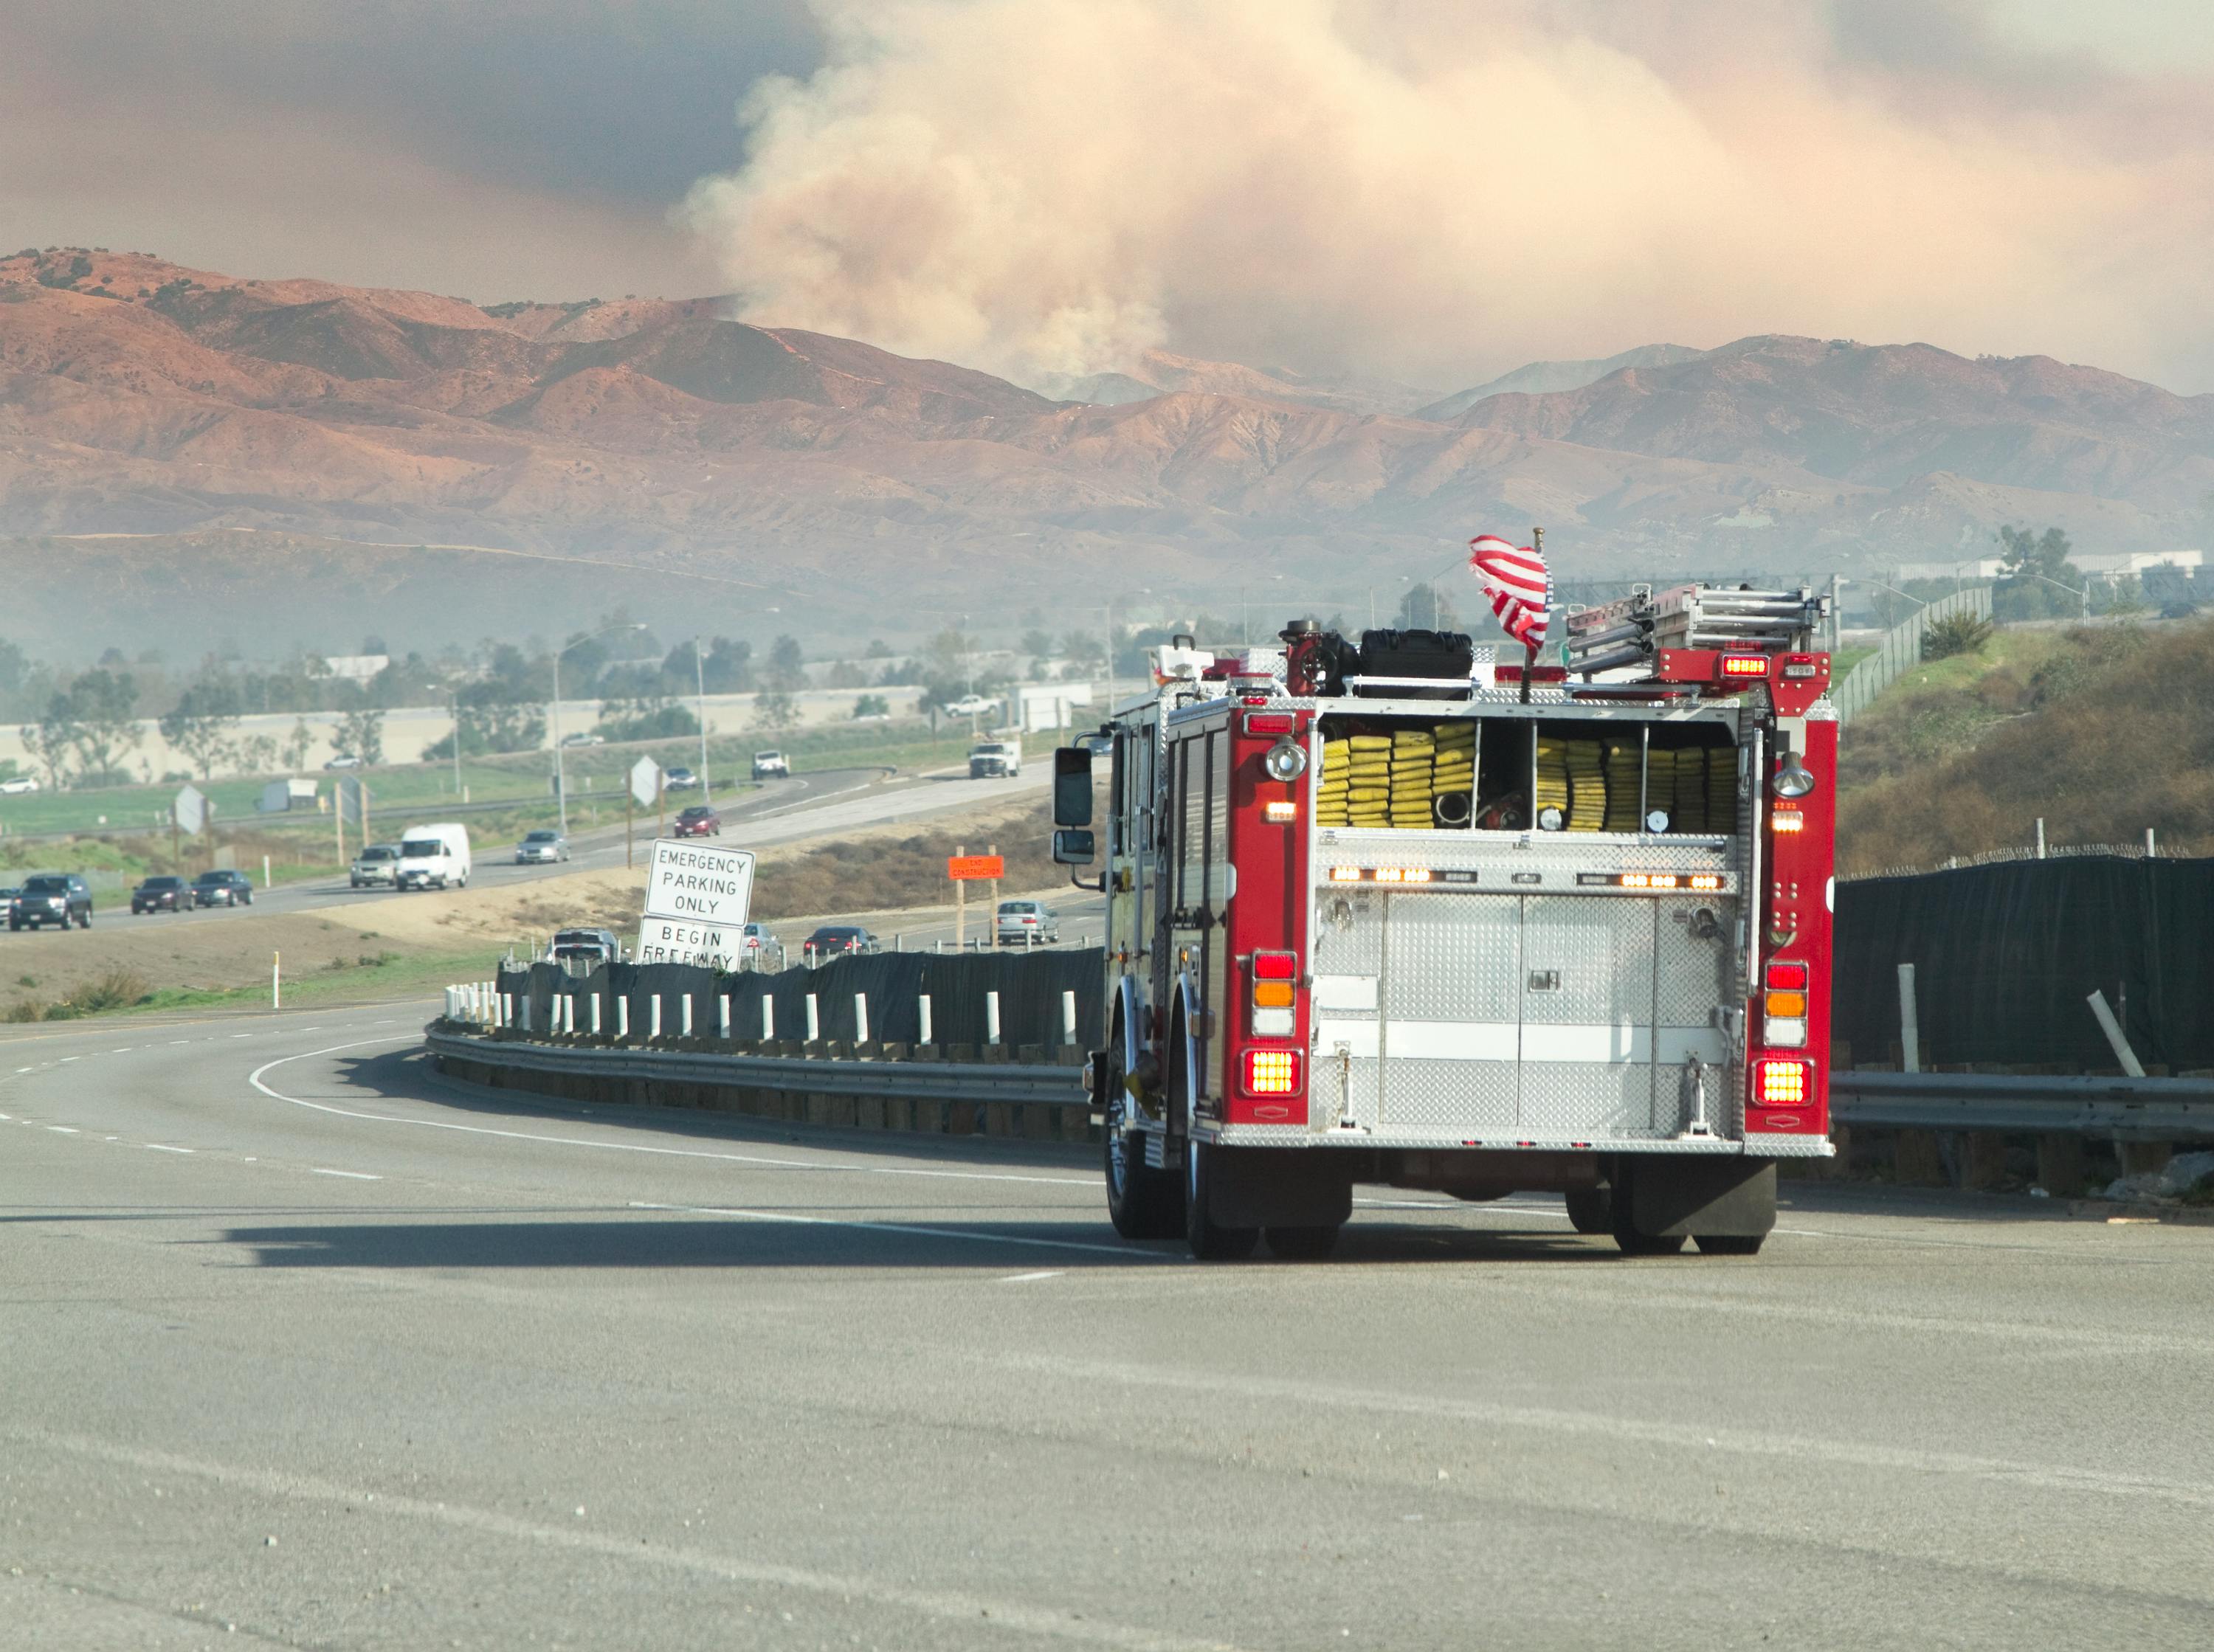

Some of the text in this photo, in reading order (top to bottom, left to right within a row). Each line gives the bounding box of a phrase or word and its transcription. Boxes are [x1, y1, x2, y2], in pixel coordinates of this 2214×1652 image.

[659, 850, 746, 874] EMERGENCY
[663, 872, 737, 896] PARKING
[675, 896, 720, 914] ONLY
[662, 926, 721, 947] BEGIN
